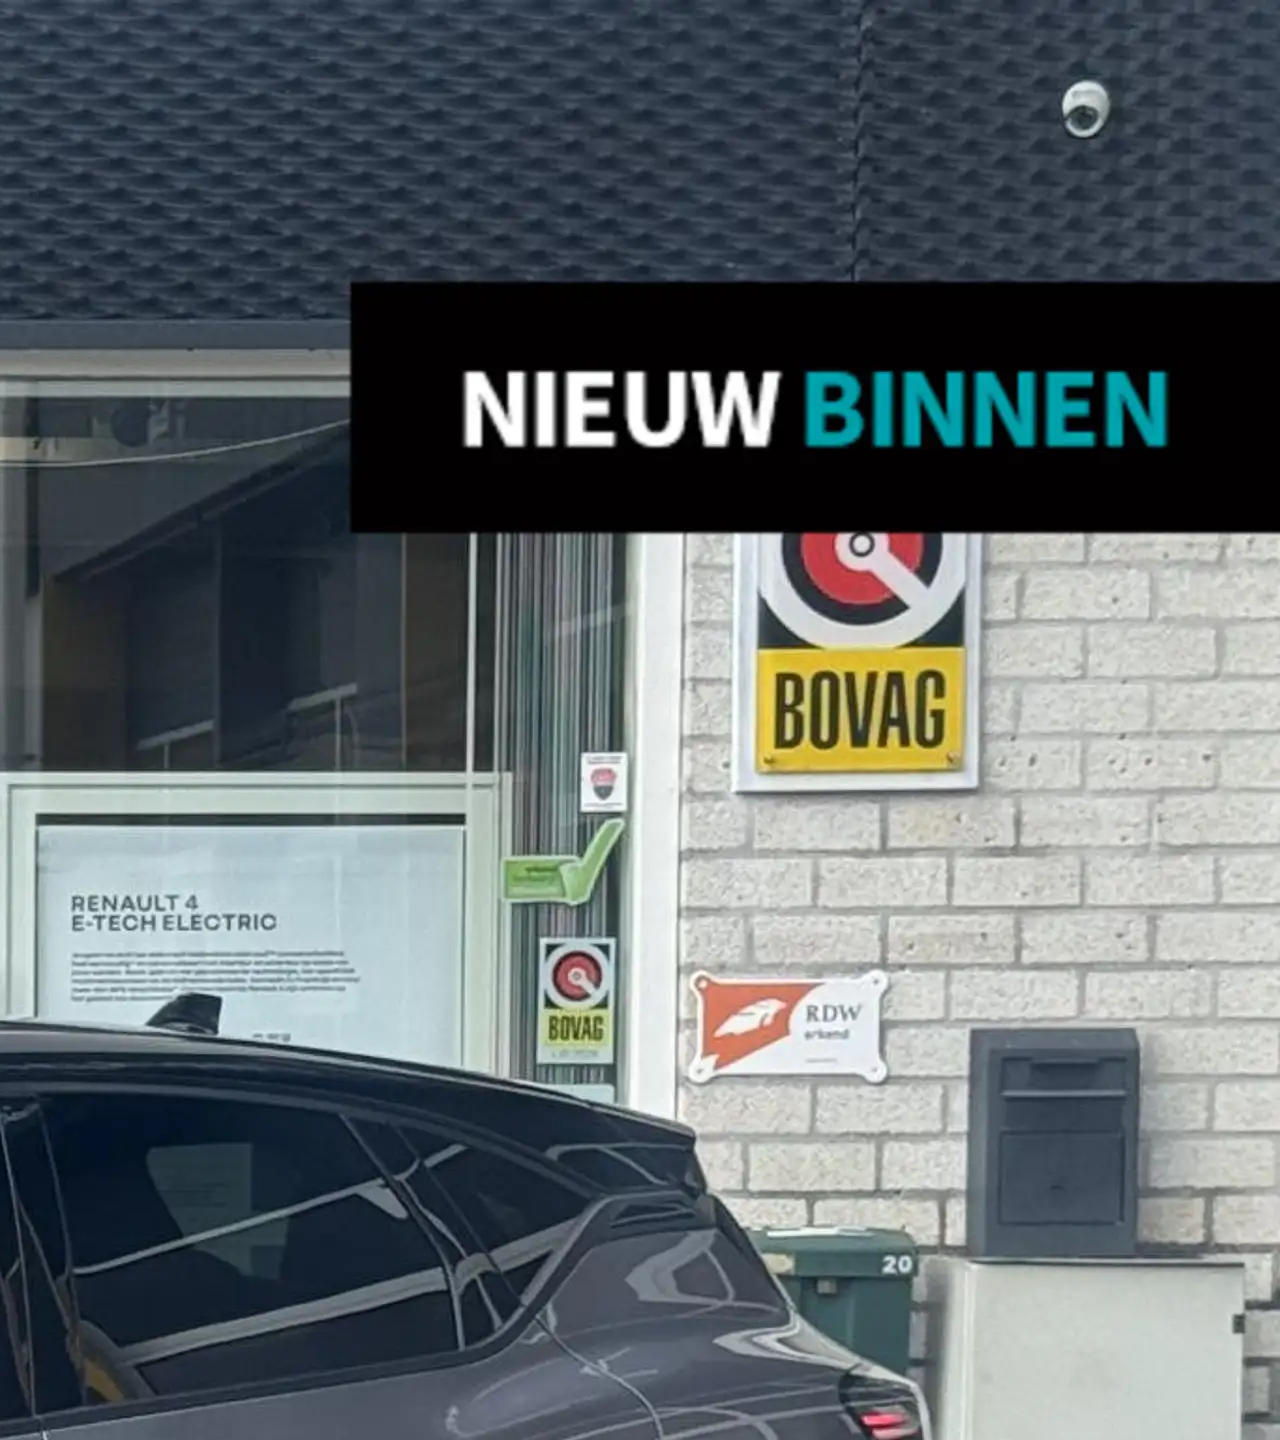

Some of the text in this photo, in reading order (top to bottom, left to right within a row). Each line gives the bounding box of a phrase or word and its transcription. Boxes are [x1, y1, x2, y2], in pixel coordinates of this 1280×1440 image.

[774, 669, 946, 750] BOVAG
[71, 894, 199, 912] RENAULT 4
[71, 913, 278, 932] E-TECH ELECTRIC
[806, 1003, 862, 1022] RDW
[548, 1015, 604, 1041] BOVAG
[882, 1255, 912, 1274] 20
